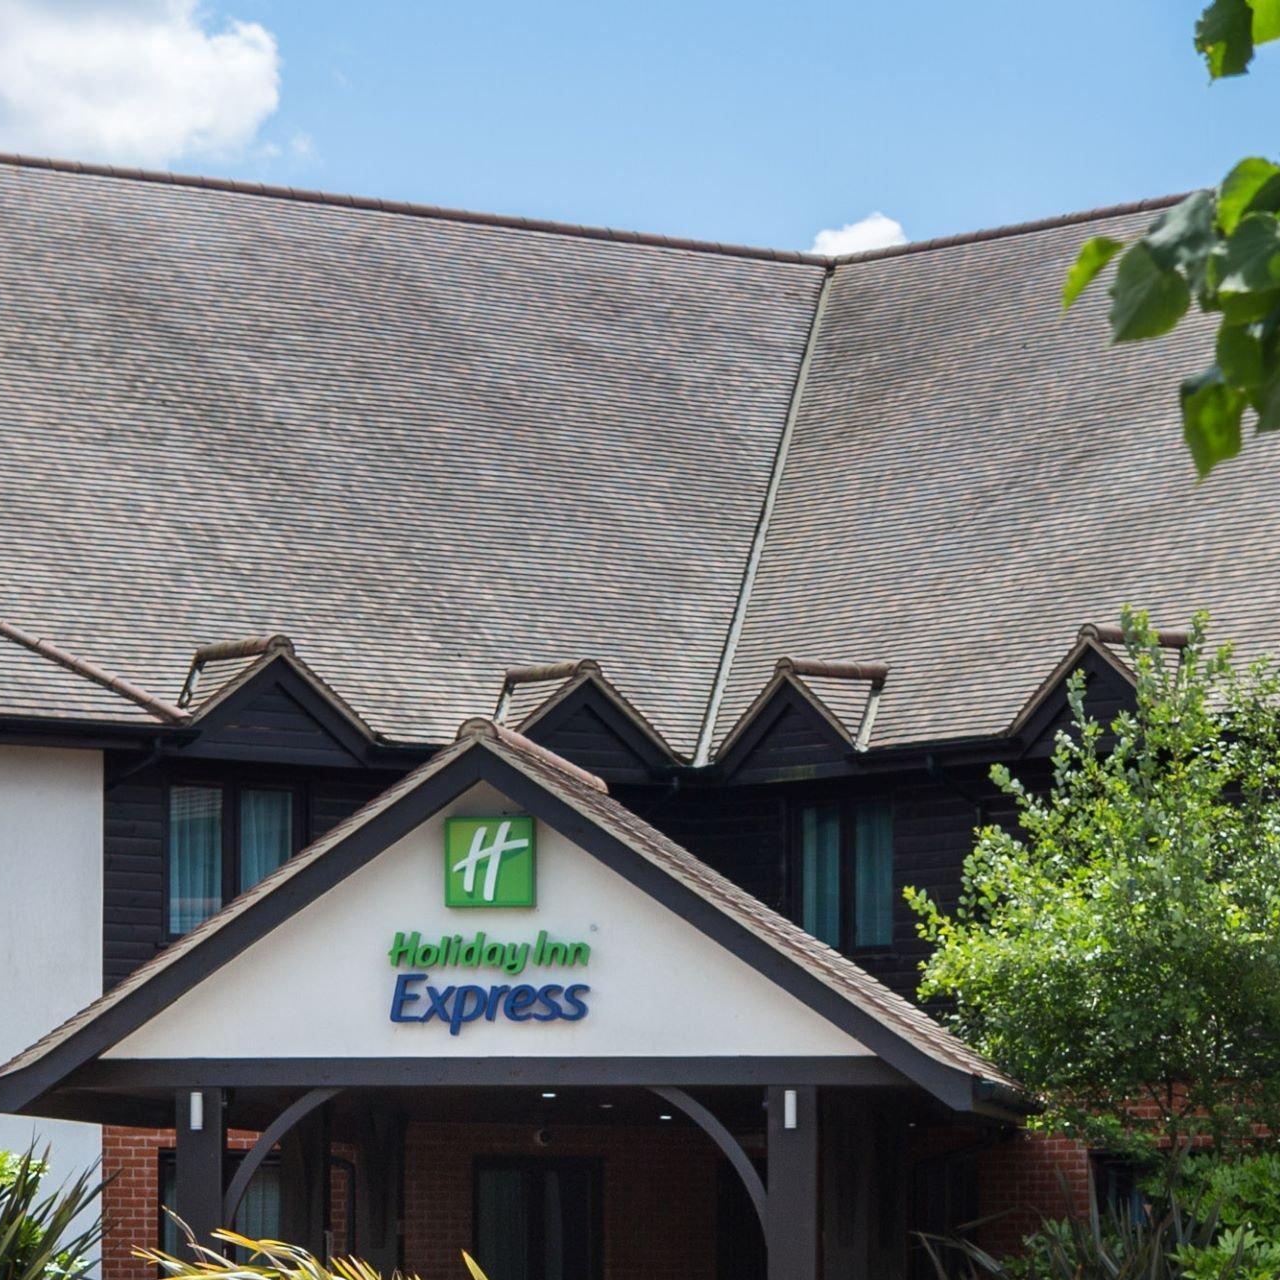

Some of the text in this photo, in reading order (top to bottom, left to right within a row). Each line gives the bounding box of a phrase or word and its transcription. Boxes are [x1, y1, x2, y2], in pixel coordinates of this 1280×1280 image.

[388, 930, 591, 975] Holiday Inn
[390, 973, 591, 1036] Express
